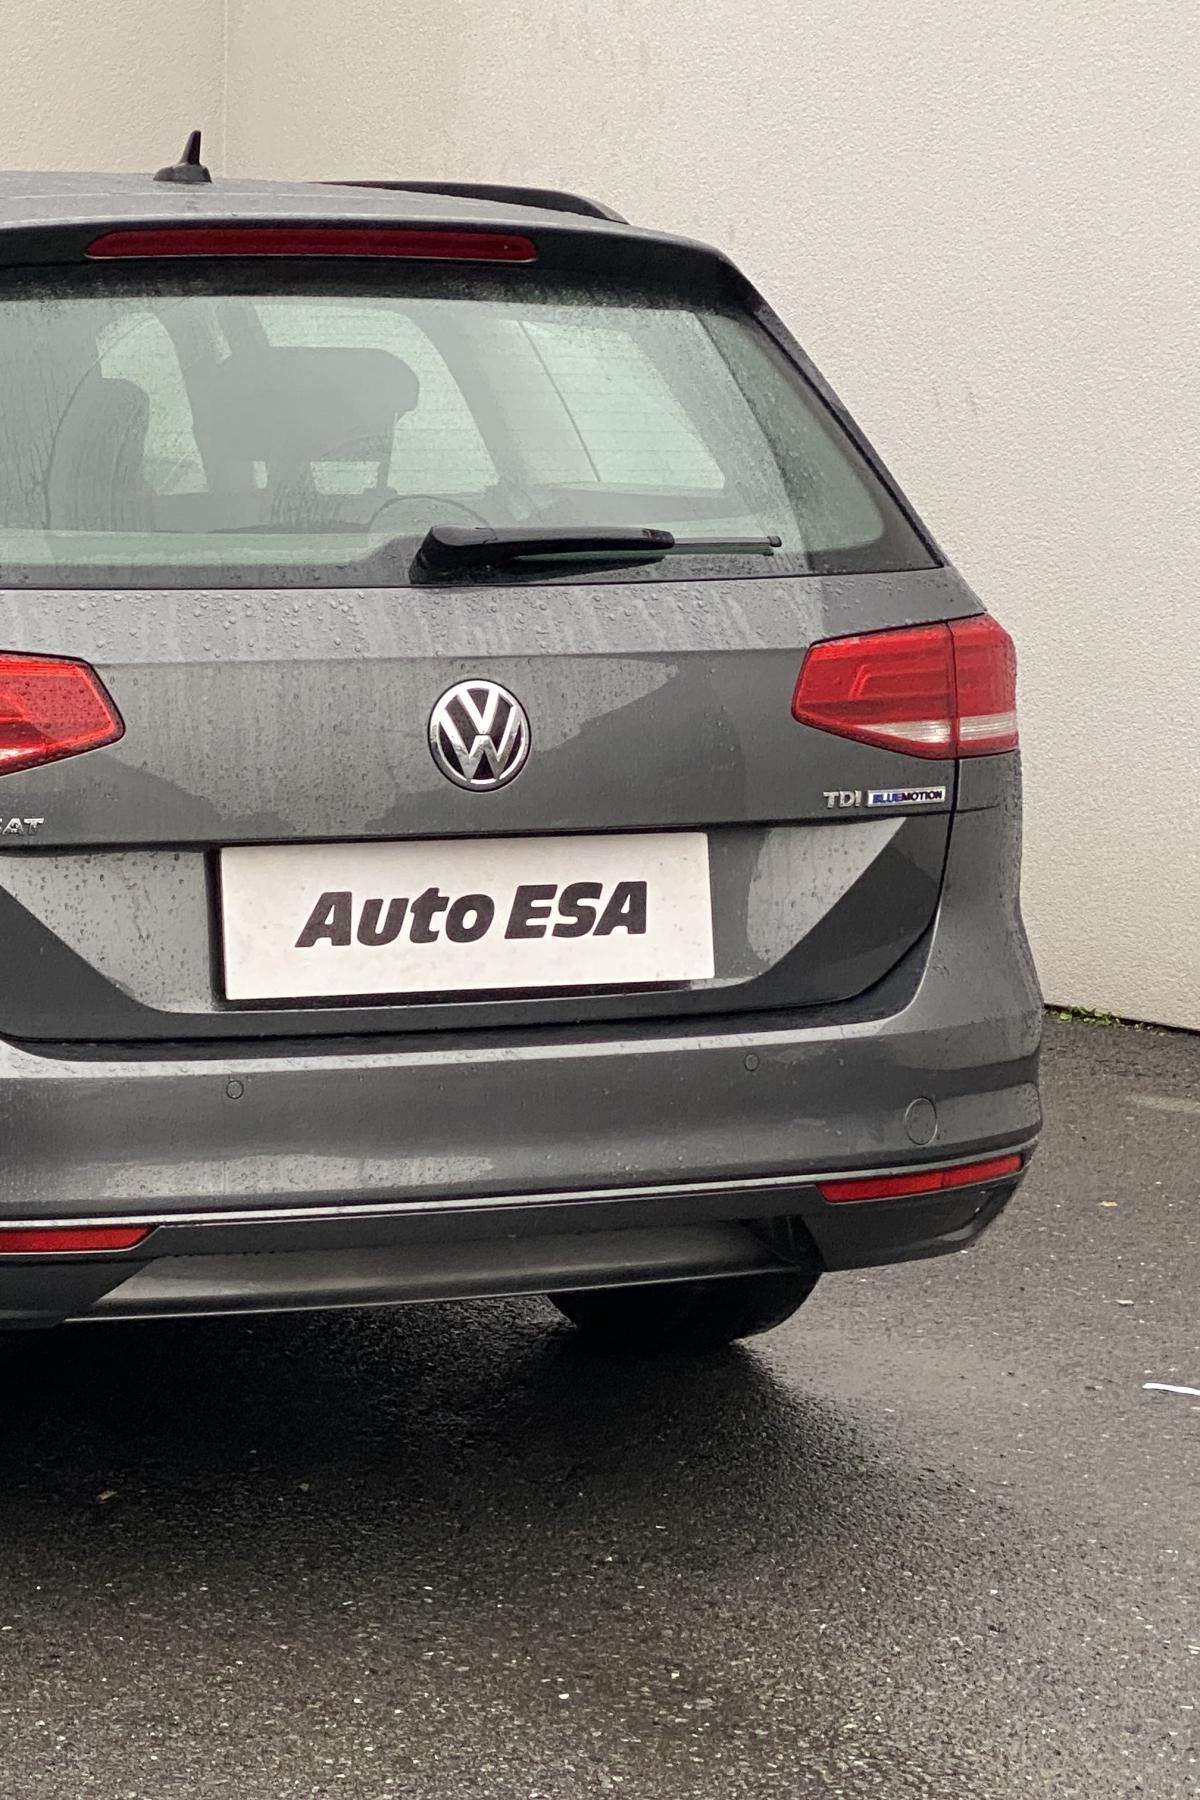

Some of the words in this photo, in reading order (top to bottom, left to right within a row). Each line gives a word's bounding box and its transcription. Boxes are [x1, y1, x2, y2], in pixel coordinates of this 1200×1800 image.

[823, 790, 862, 808] TDI
[873, 790, 942, 804] BLUEMOTION
[294, 887, 495, 948] Auto
[504, 881, 648, 940] ESA
